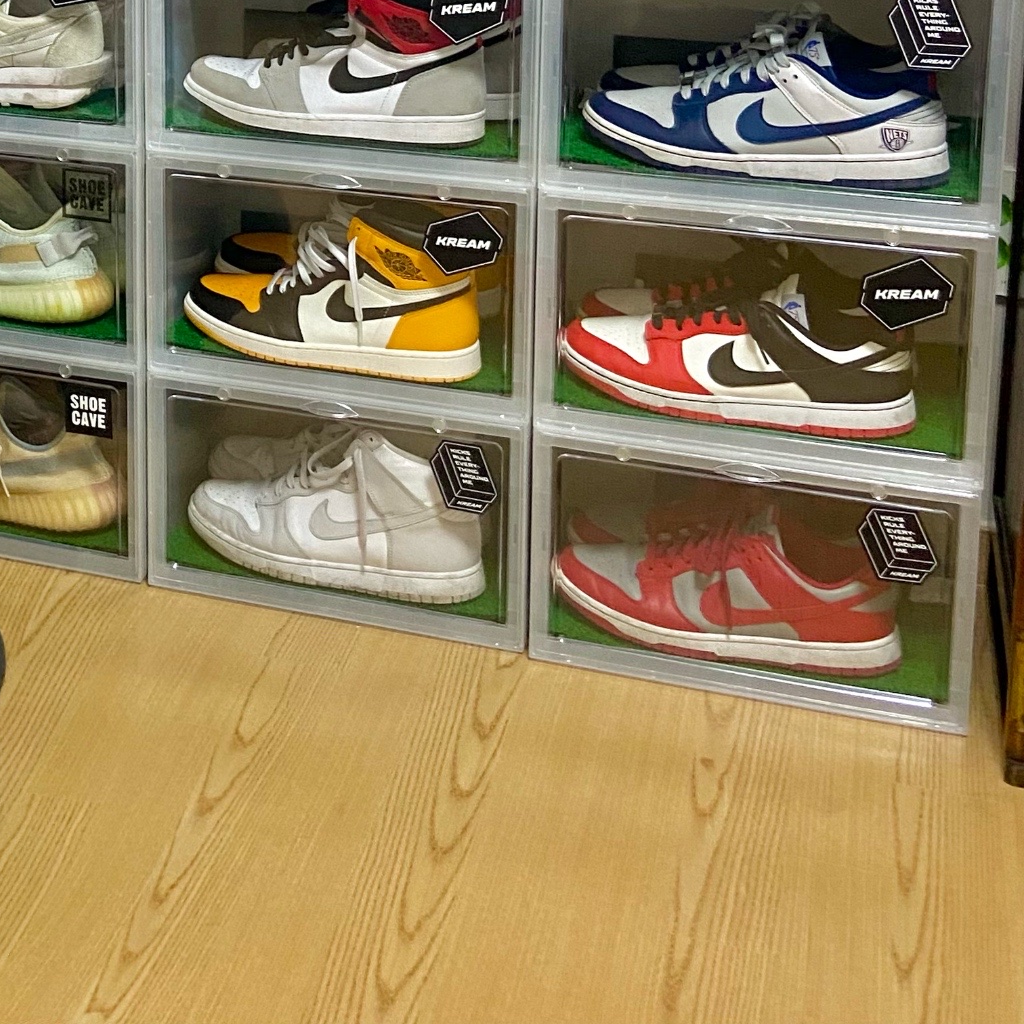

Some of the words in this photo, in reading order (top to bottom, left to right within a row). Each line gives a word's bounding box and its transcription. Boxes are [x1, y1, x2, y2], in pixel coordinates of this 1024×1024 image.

[440, 1, 497, 16] KREAM
[885, 128, 907, 143] NETS
[69, 177, 105, 196] SHOE
[70, 194, 104, 212] CAVE
[435, 235, 492, 251] KREAM
[874, 288, 940, 300] KREAM
[70, 393, 107, 413] SHOE
[71, 410, 107, 429] CAVE
